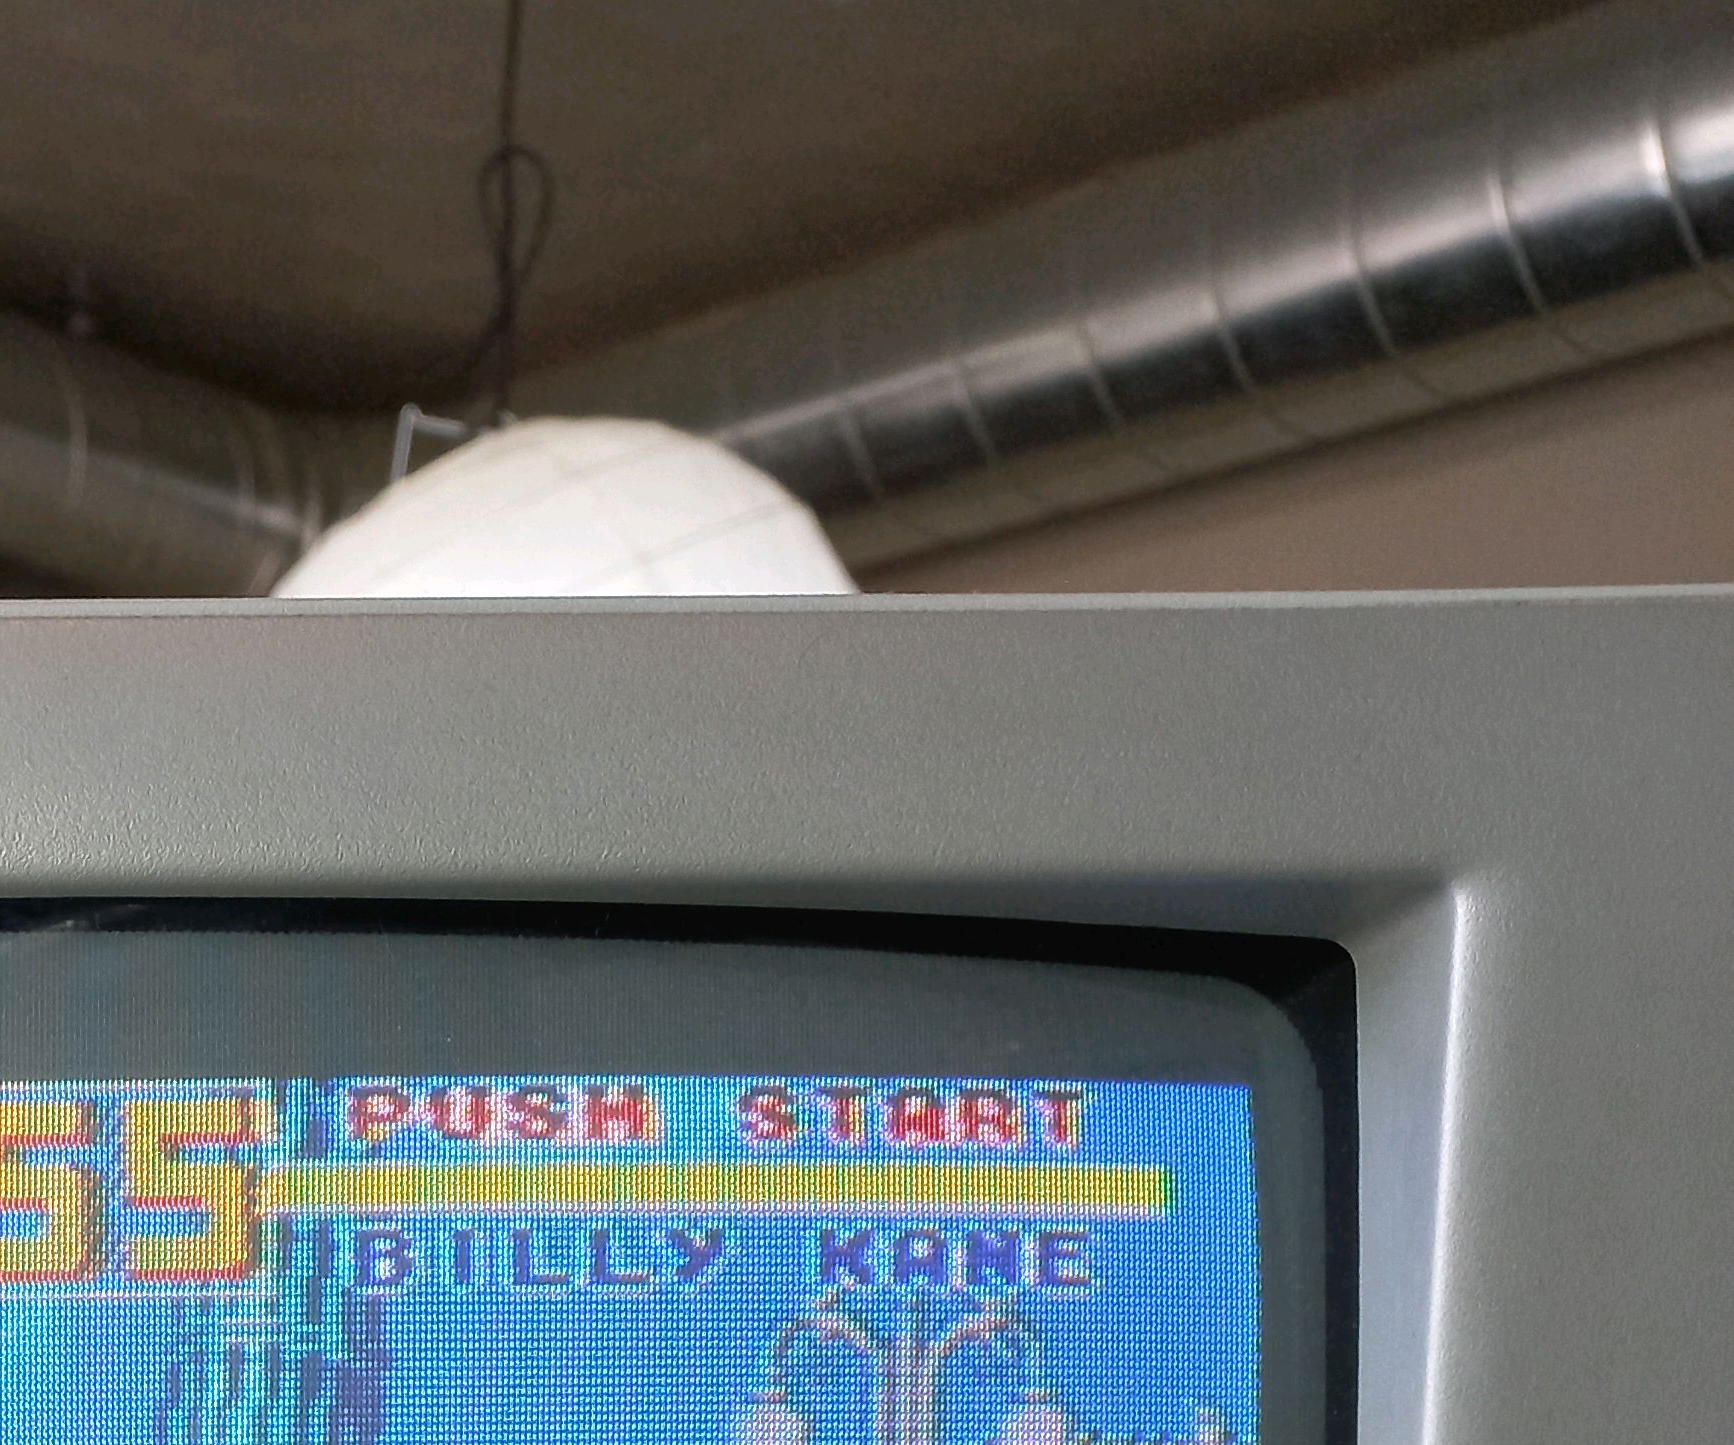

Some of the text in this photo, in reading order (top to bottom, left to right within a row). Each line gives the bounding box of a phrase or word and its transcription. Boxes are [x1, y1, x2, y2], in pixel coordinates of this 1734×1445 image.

[342, 1081, 1090, 1150] PUSH START
[350, 1224, 1095, 1297] BILLY KANE
